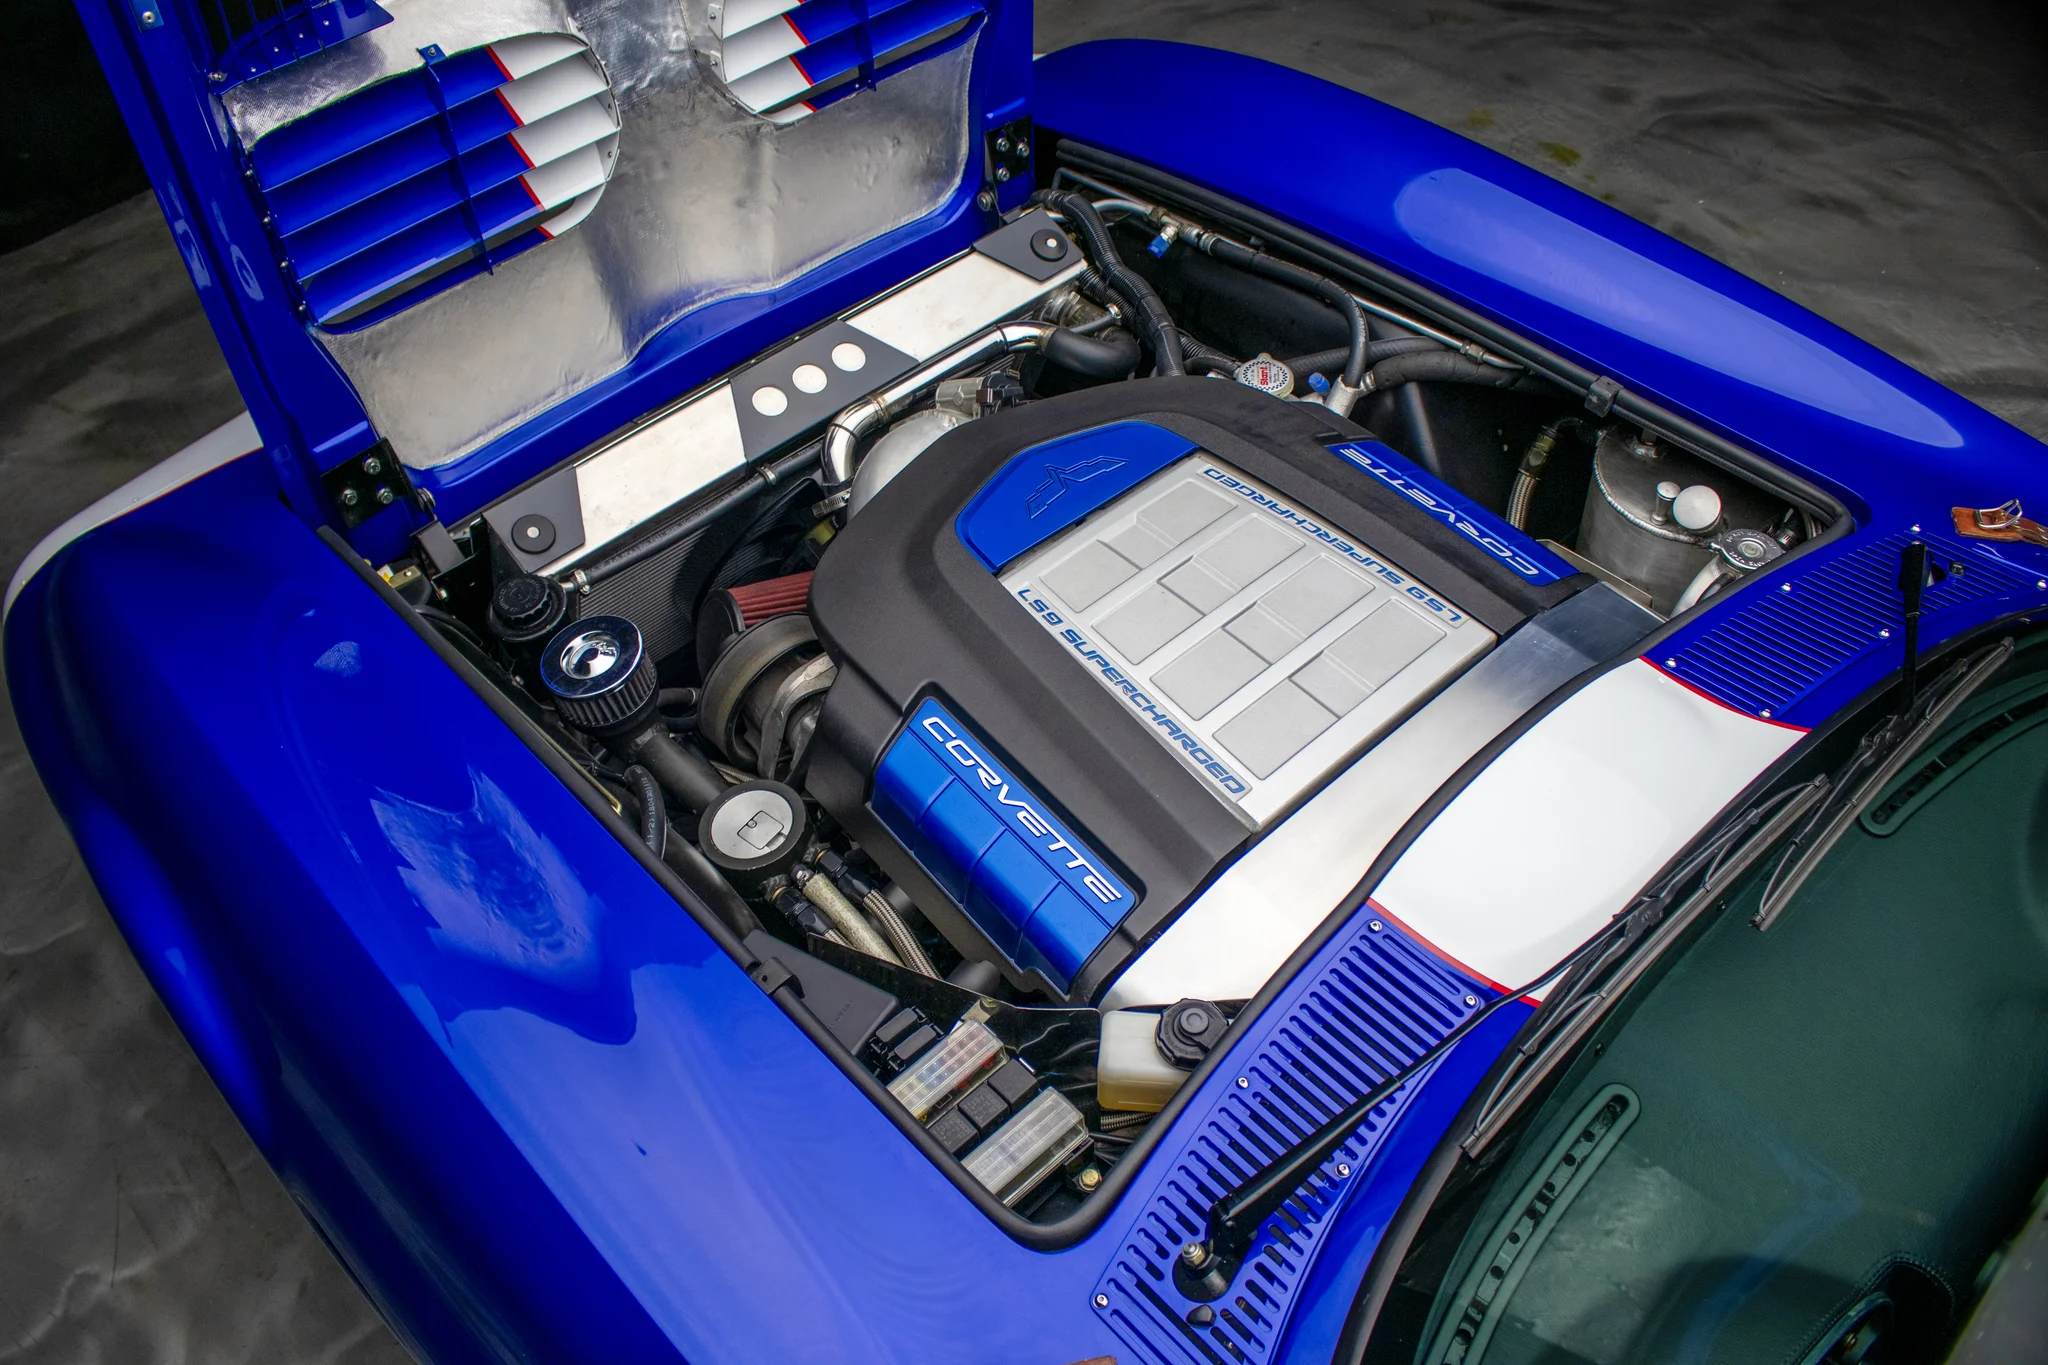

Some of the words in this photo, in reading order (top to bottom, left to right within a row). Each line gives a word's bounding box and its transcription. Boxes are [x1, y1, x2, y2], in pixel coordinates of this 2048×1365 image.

[1260, 366, 1269, 386] Stant
[1203, 468, 1406, 586] SUPERCHARGED
[1339, 448, 1539, 576] CORVETTE
[1405, 586, 1462, 623] LS9
[1017, 588, 1064, 627] LS9
[1059, 628, 1246, 794] SUPERCHARGED
[922, 716, 1123, 904] CORVETTE
